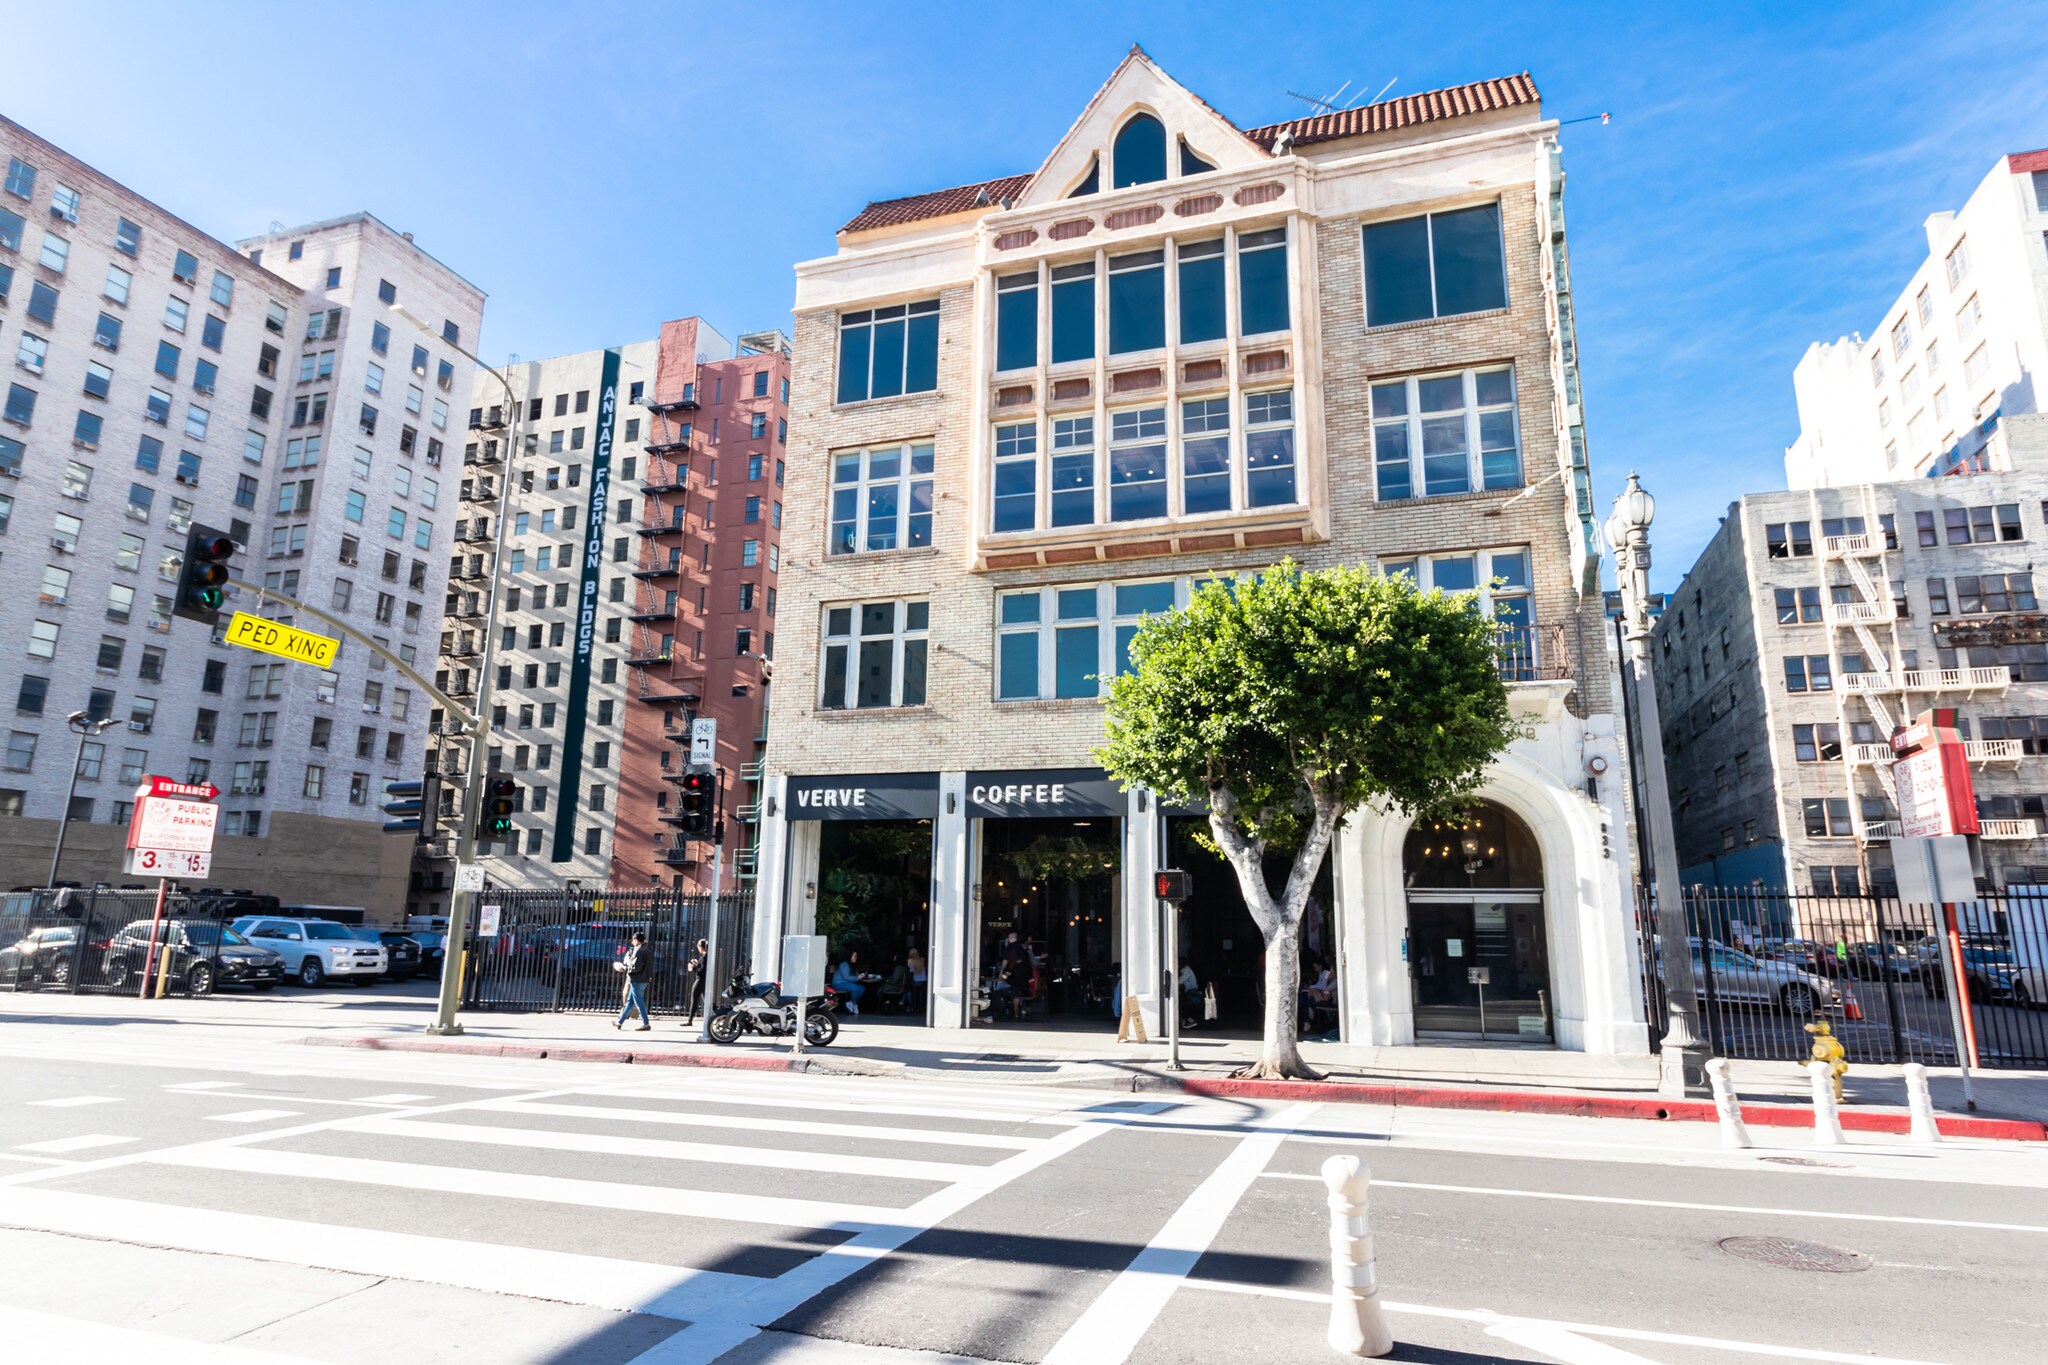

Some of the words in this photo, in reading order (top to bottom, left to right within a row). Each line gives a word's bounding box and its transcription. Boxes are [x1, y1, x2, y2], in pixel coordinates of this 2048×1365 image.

[598, 386, 615, 456] ANJAC
[587, 468, 607, 568] FASHION
[238, 621, 278, 646] PED
[284, 634, 327, 660] XING
[693, 752, 712, 760] SIGNAL
[158, 781, 212, 797] ENTRANCE
[797, 788, 866, 808] VERVE
[972, 784, 1065, 804] COFFEE
[178, 804, 211, 815] PUBLIC
[172, 816, 213, 828] PARKING
